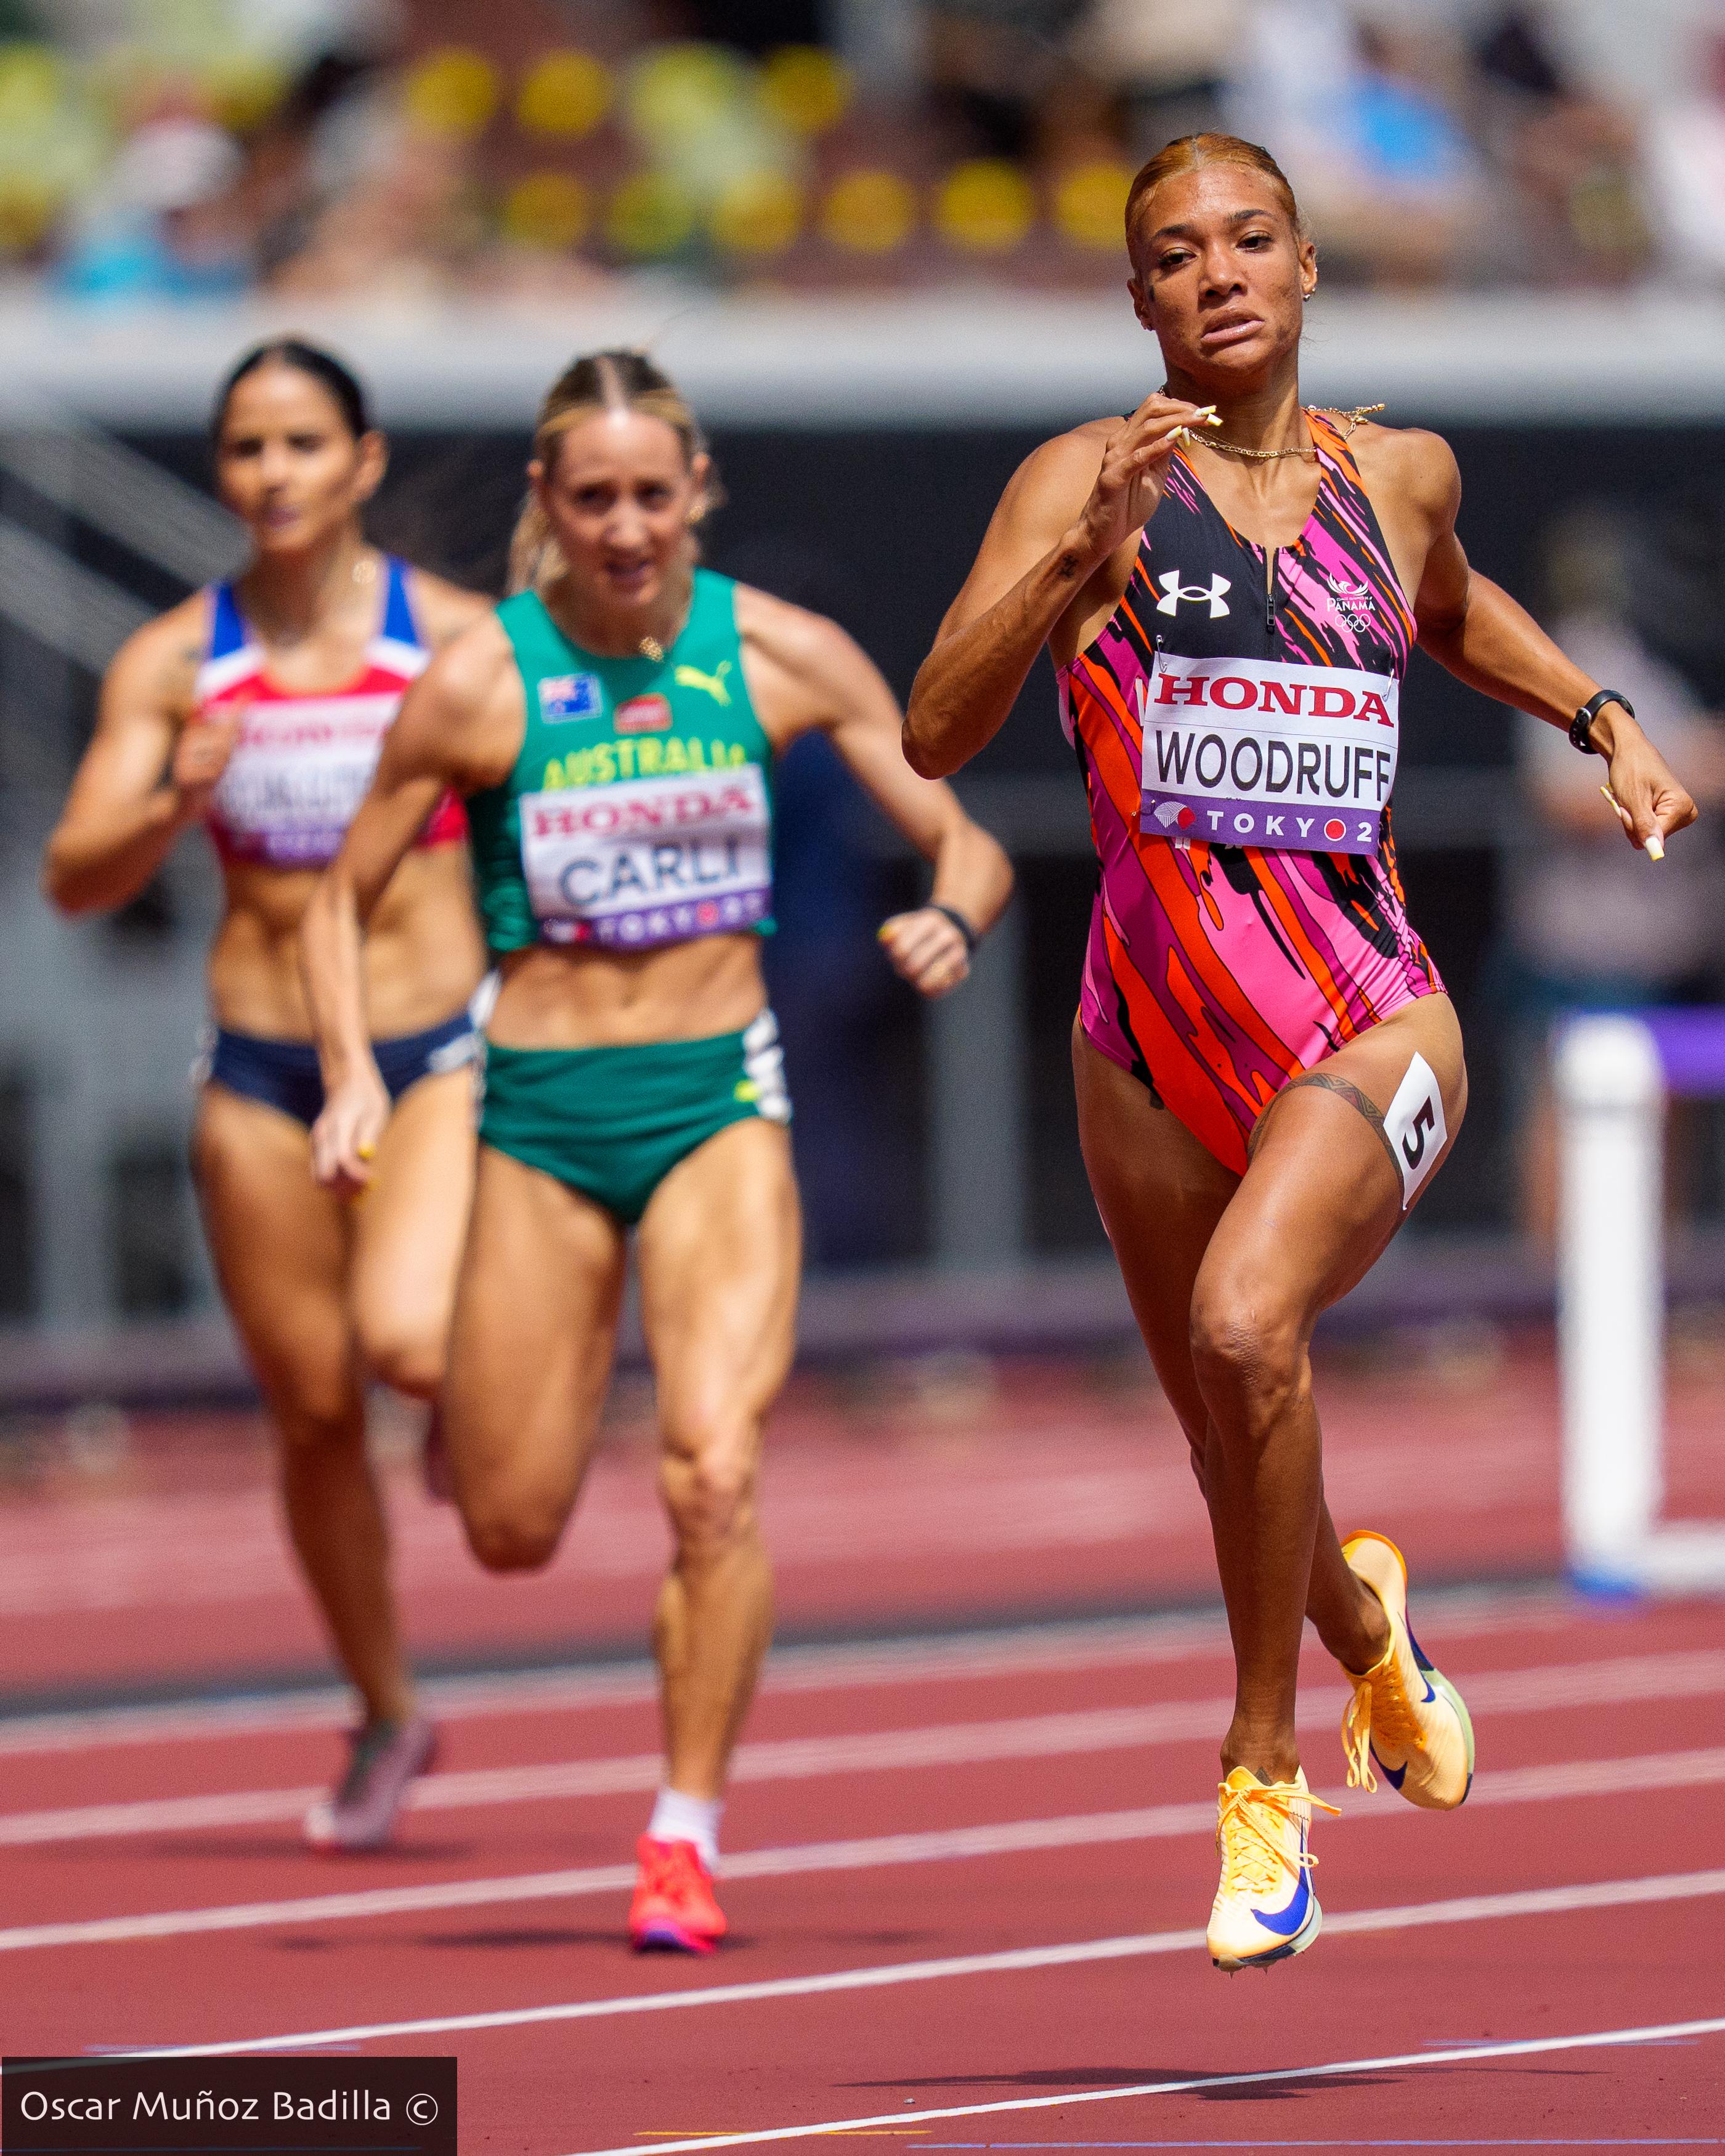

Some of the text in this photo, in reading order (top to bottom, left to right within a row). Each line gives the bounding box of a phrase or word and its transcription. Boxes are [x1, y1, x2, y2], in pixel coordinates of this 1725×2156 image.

[1326, 596, 1376, 612] PANAMÁ
[1154, 673, 1394, 728] HONDA
[1156, 730, 1391, 801] WOODRUFF
[535, 785, 752, 838] HONDA
[559, 836, 740, 906] CARLI
[1402, 1095, 1435, 1170] 5
